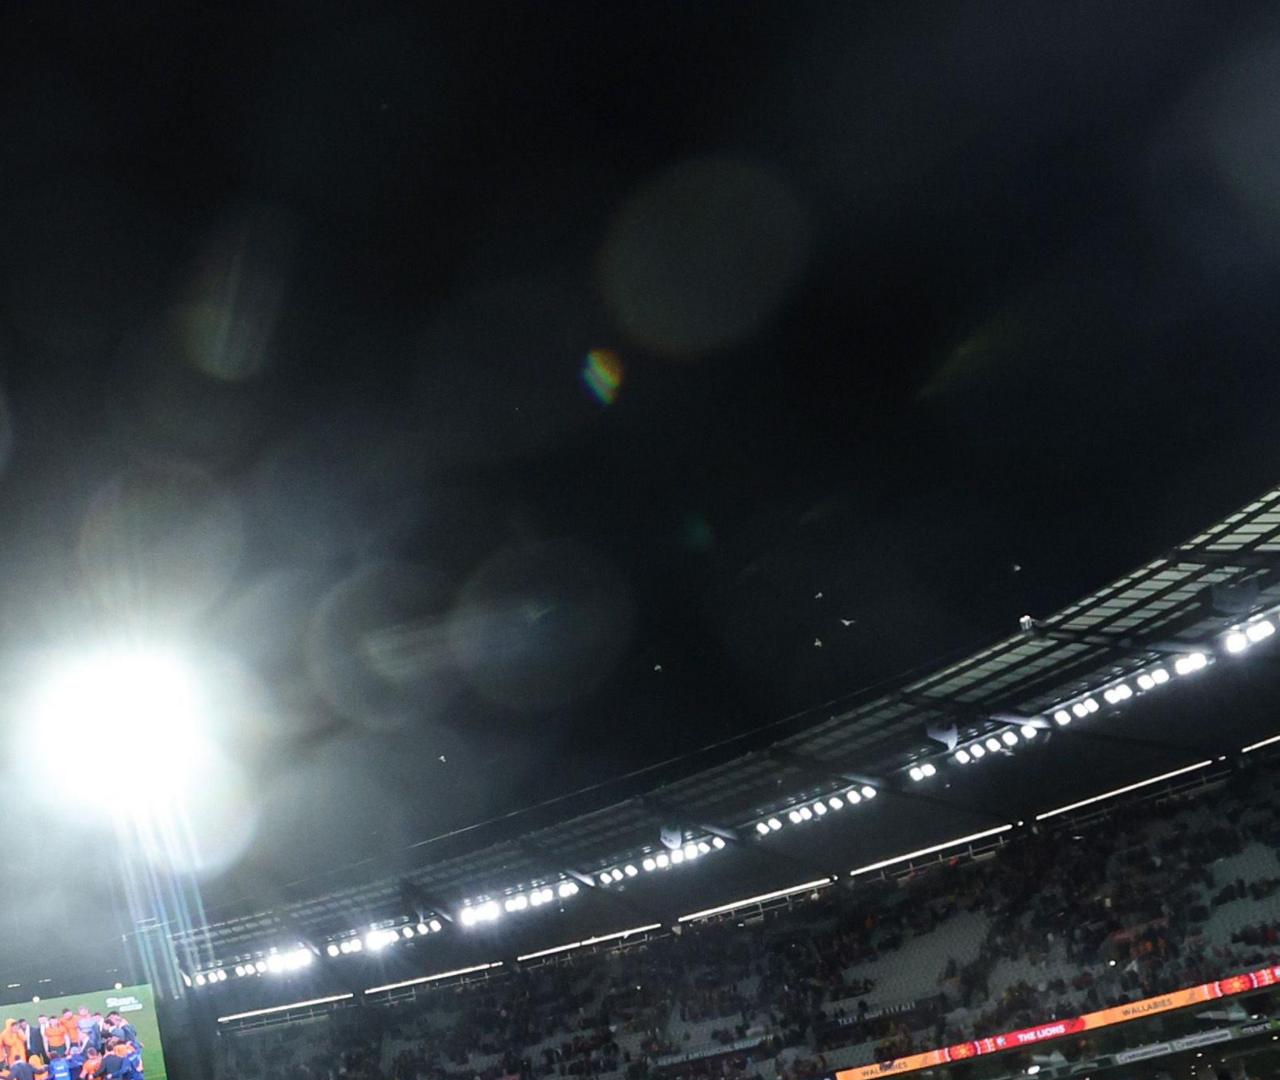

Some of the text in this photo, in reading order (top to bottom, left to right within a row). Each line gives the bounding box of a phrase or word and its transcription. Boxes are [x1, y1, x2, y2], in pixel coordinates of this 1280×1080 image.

[1122, 998, 1173, 1017] WALLABIES
[1017, 1025, 1066, 1043] THE LIONS
